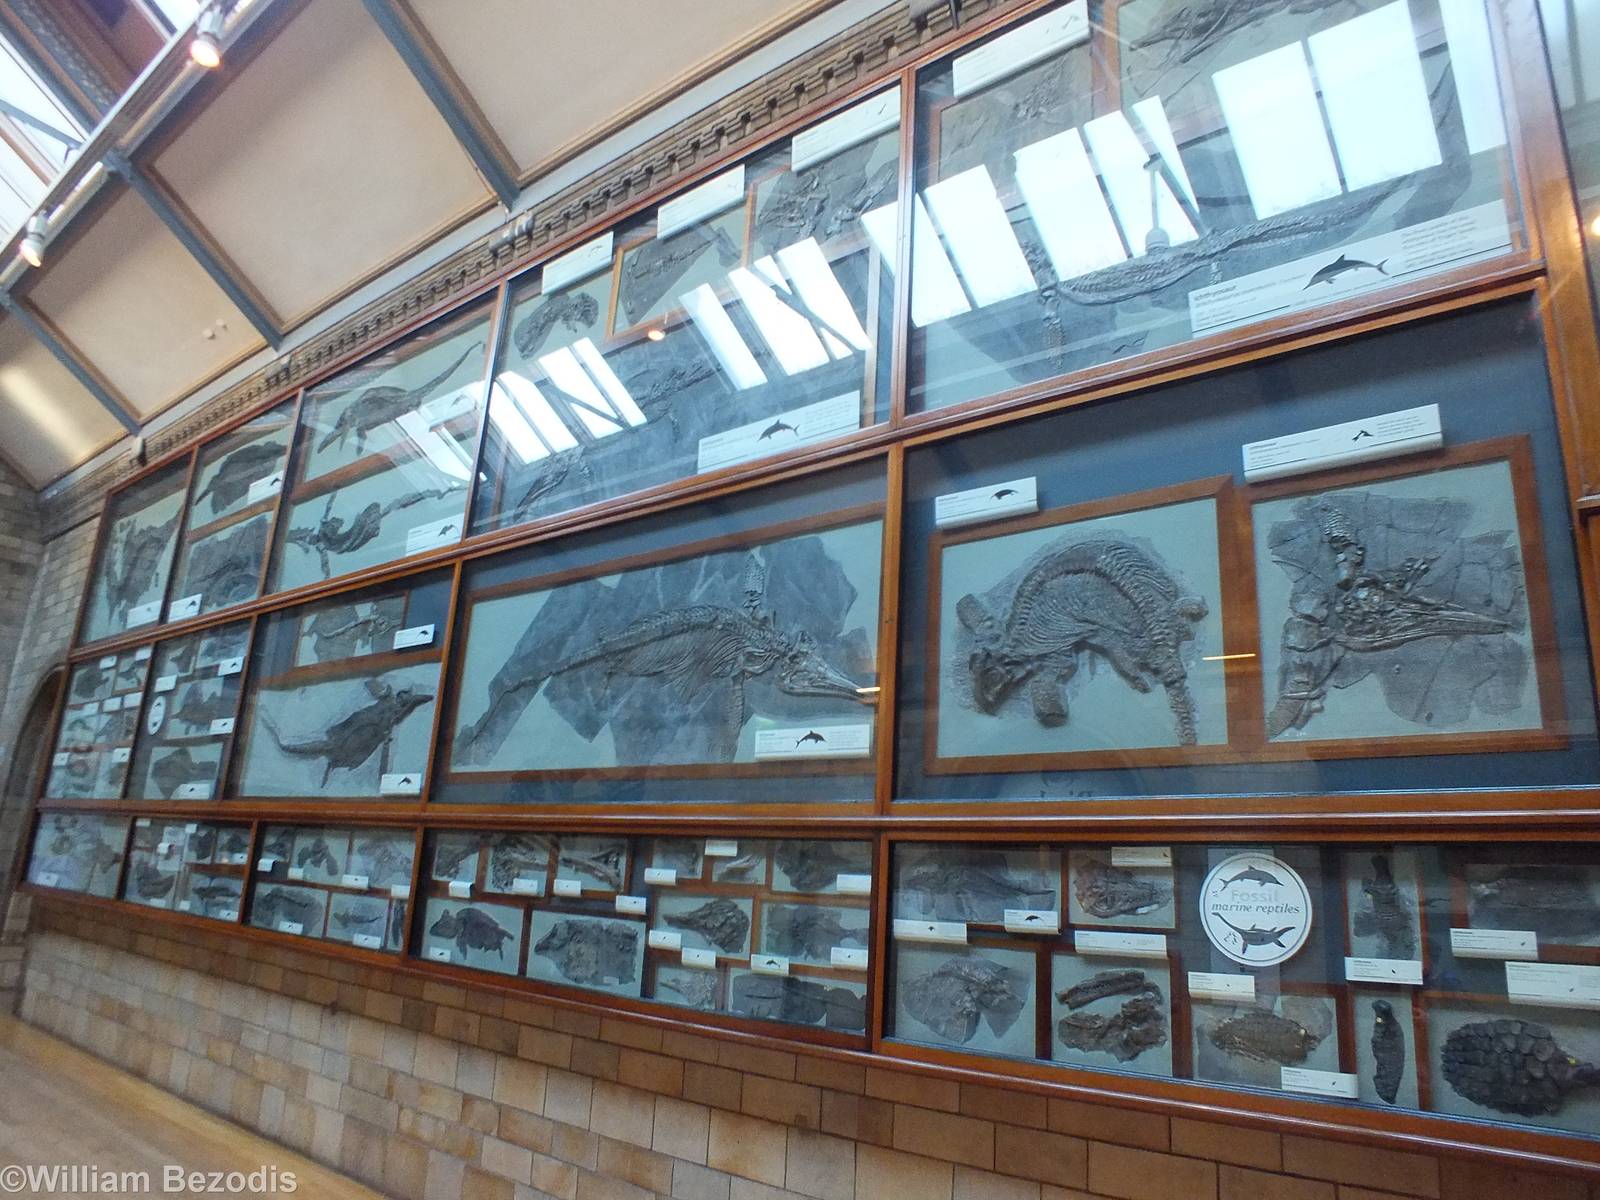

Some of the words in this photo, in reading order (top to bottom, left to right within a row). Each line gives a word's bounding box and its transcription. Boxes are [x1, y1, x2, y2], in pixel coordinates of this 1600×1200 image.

[1231, 889, 1279, 902] Fossil
[1212, 902, 1252, 911] marine
[1256, 903, 1300, 915] reptiles
